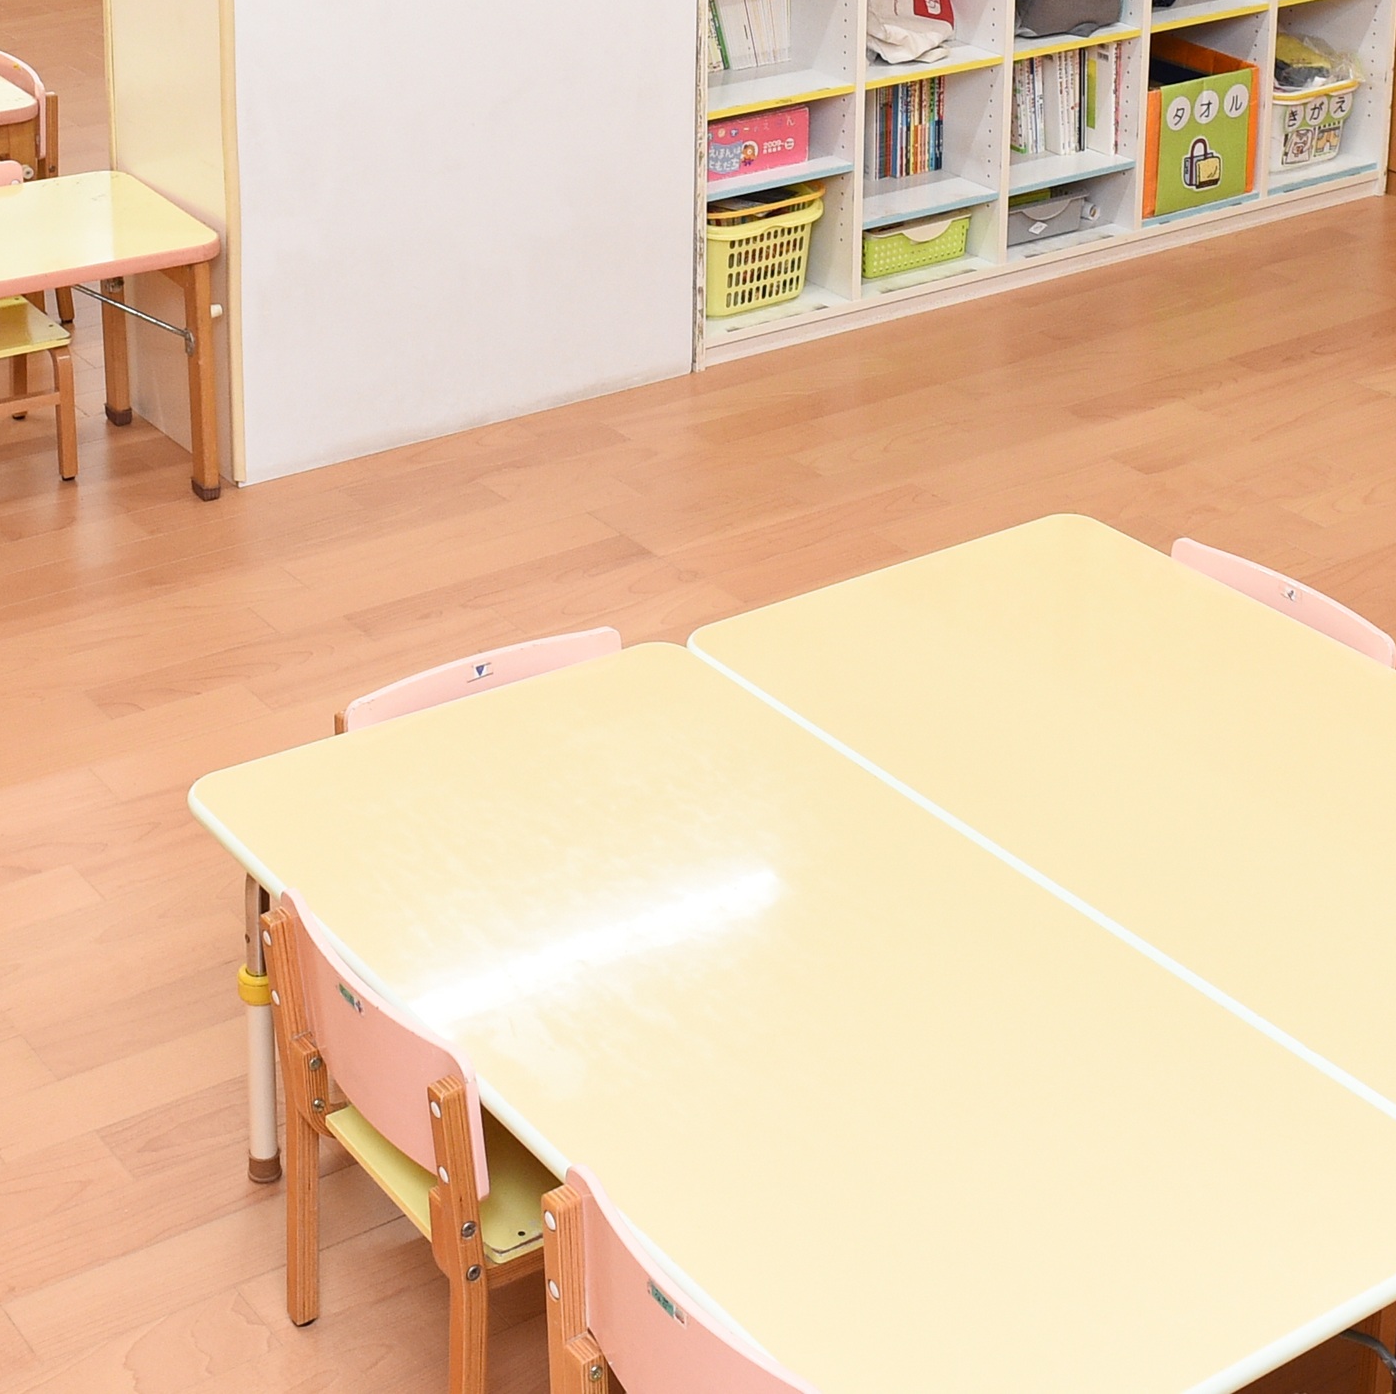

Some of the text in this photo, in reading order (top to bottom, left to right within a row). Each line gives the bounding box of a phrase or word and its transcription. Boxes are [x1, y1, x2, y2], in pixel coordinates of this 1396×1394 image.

[1173, 96, 1243, 127] タオル
[1287, 98, 1346, 128] きがえ
[709, 146, 742, 158] えほんは
[709, 158, 740, 171] ともだち
